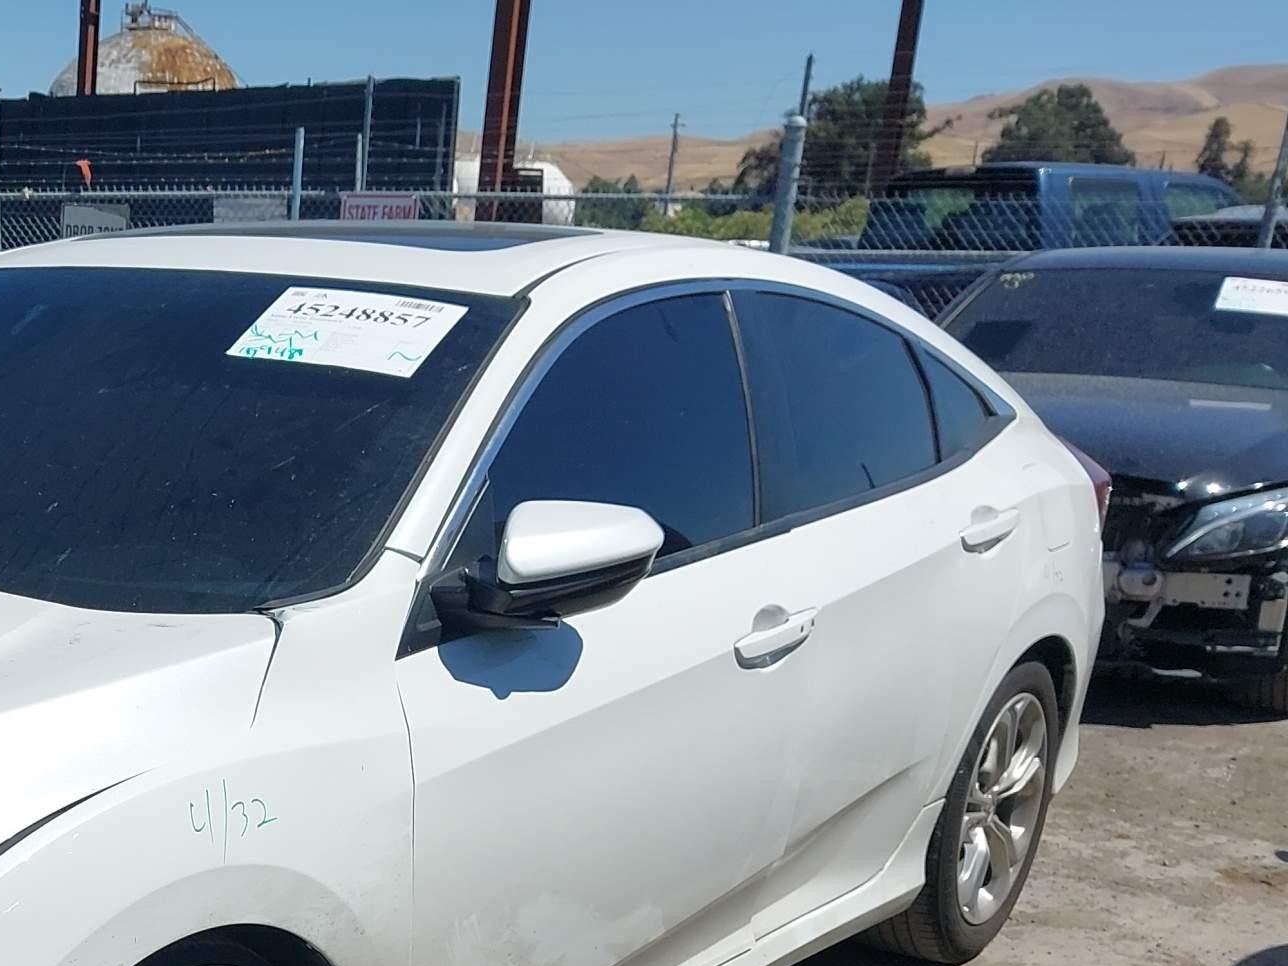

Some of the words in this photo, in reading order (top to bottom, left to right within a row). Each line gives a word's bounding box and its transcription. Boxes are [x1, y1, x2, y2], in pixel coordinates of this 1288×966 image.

[347, 204, 378, 220] STATE
[381, 204, 412, 220] FARM
[286, 302, 432, 329] 45248857
